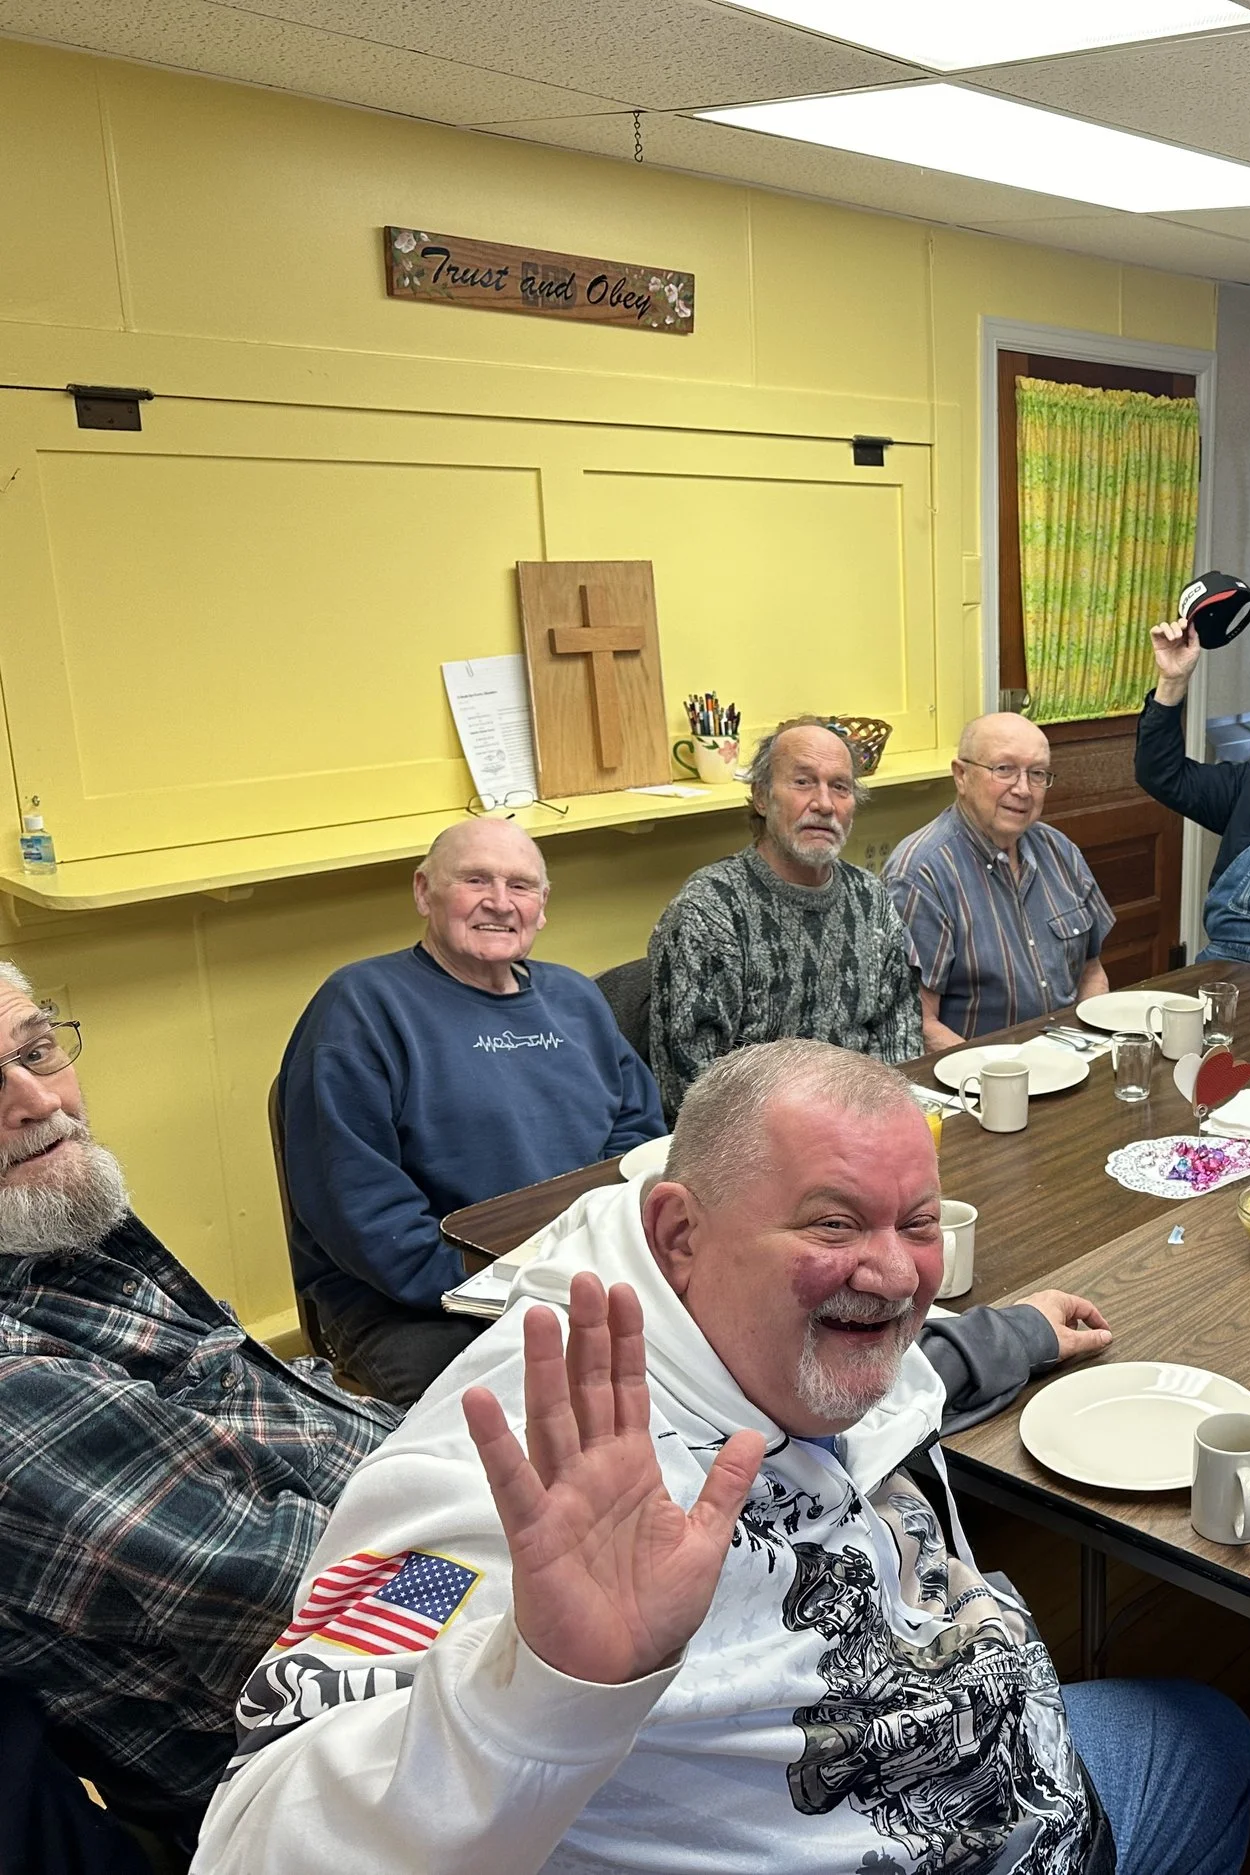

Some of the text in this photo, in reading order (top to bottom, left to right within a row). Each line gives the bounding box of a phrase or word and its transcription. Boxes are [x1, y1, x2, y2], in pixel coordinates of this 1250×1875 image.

[420, 247, 653, 320] Trust and Obey
